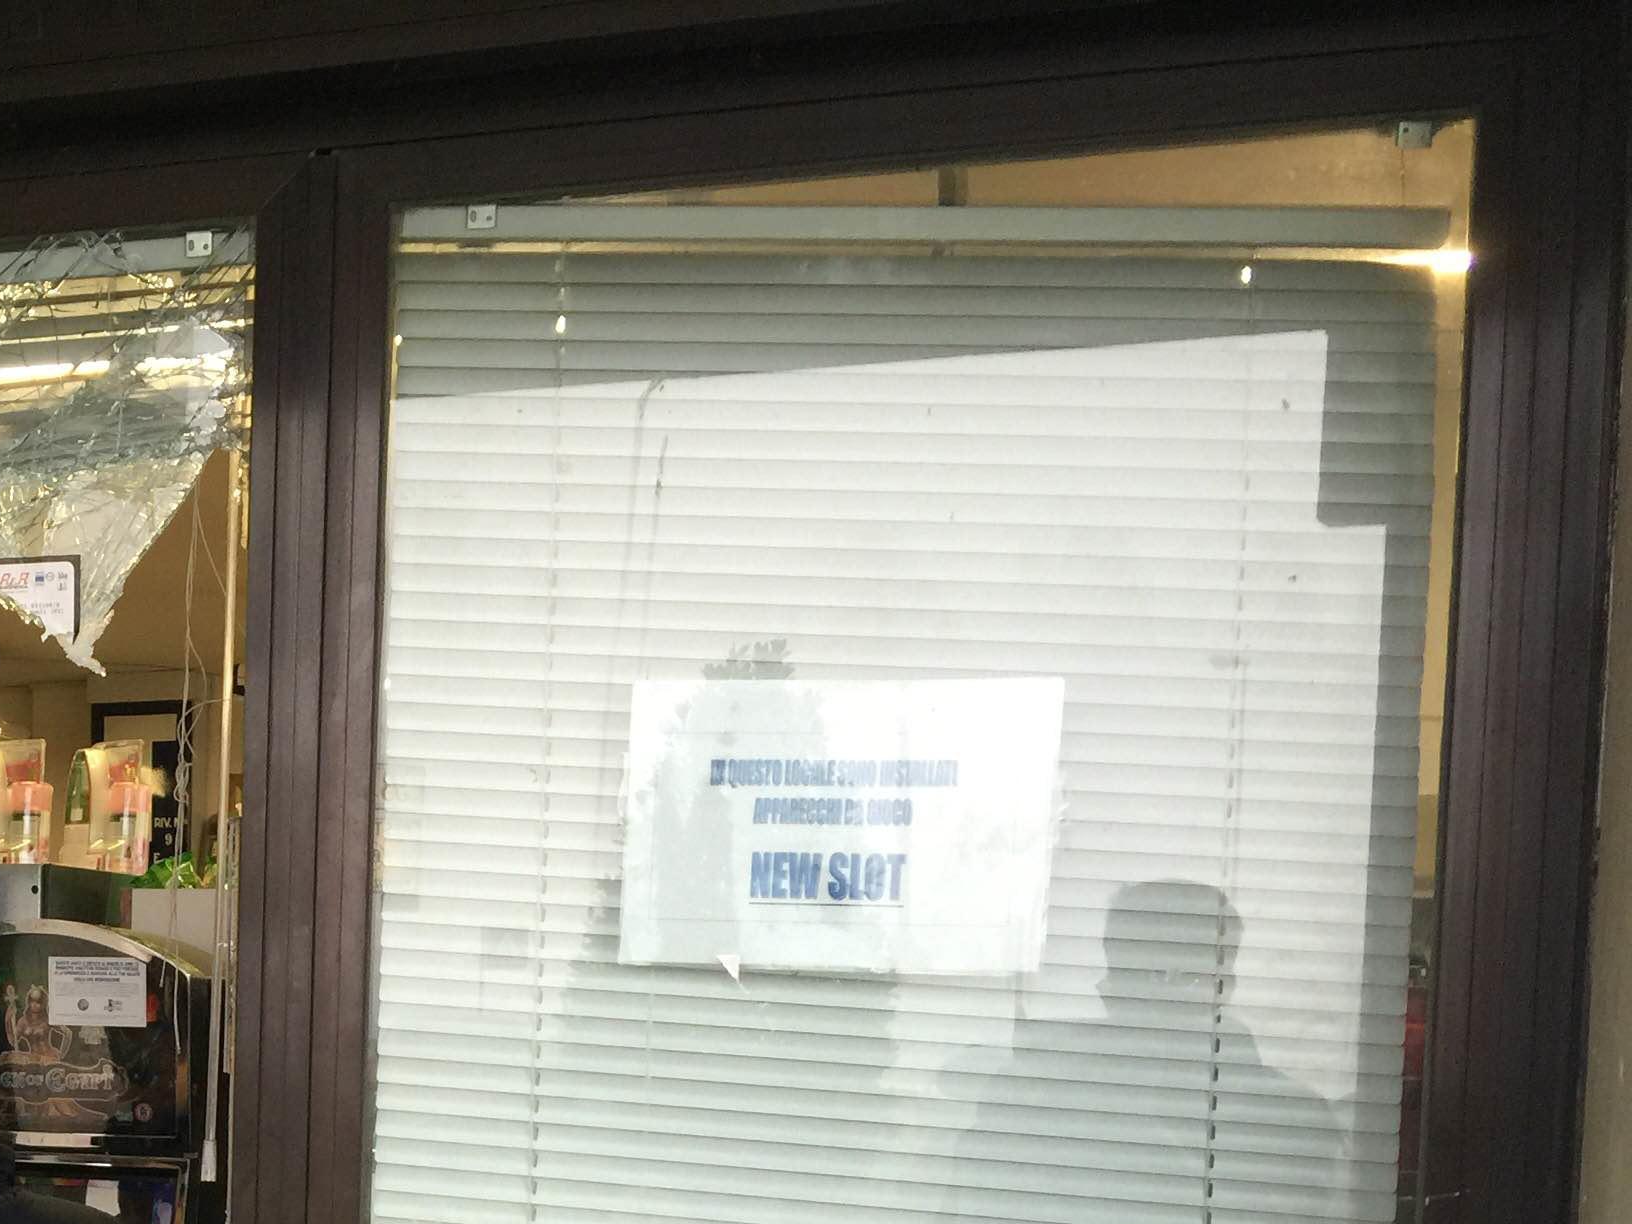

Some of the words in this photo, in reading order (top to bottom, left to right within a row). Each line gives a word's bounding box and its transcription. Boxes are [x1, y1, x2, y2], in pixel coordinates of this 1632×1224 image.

[728, 759, 783, 788] QUESTO
[750, 852, 823, 899] NEW
[827, 852, 907, 900] SLOT
